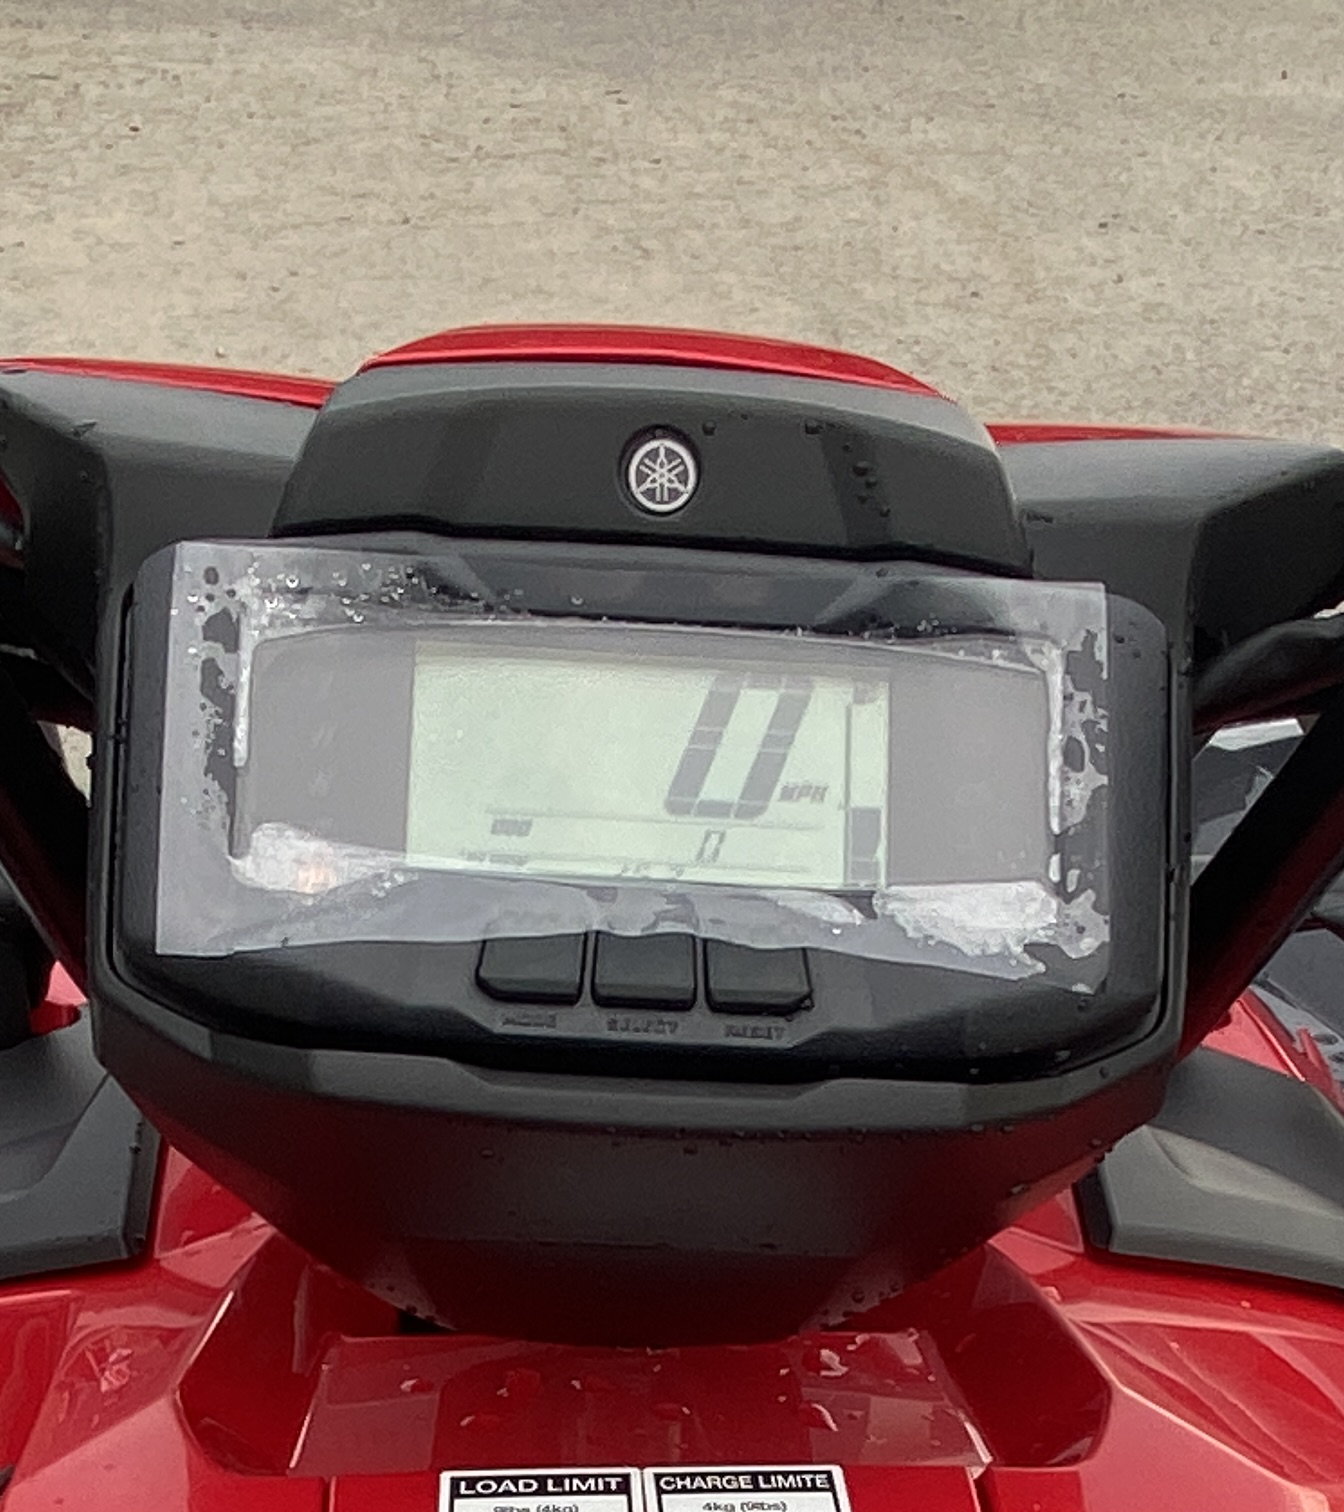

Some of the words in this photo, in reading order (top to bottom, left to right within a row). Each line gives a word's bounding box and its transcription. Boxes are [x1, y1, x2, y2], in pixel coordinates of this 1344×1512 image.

[459, 1479, 538, 1494] LOAD
[546, 1477, 623, 1492] LIMIT
[658, 1475, 754, 1491] CHARGE
[757, 1474, 830, 1489] LIMITE
[701, 1501, 736, 1512] 4kg
